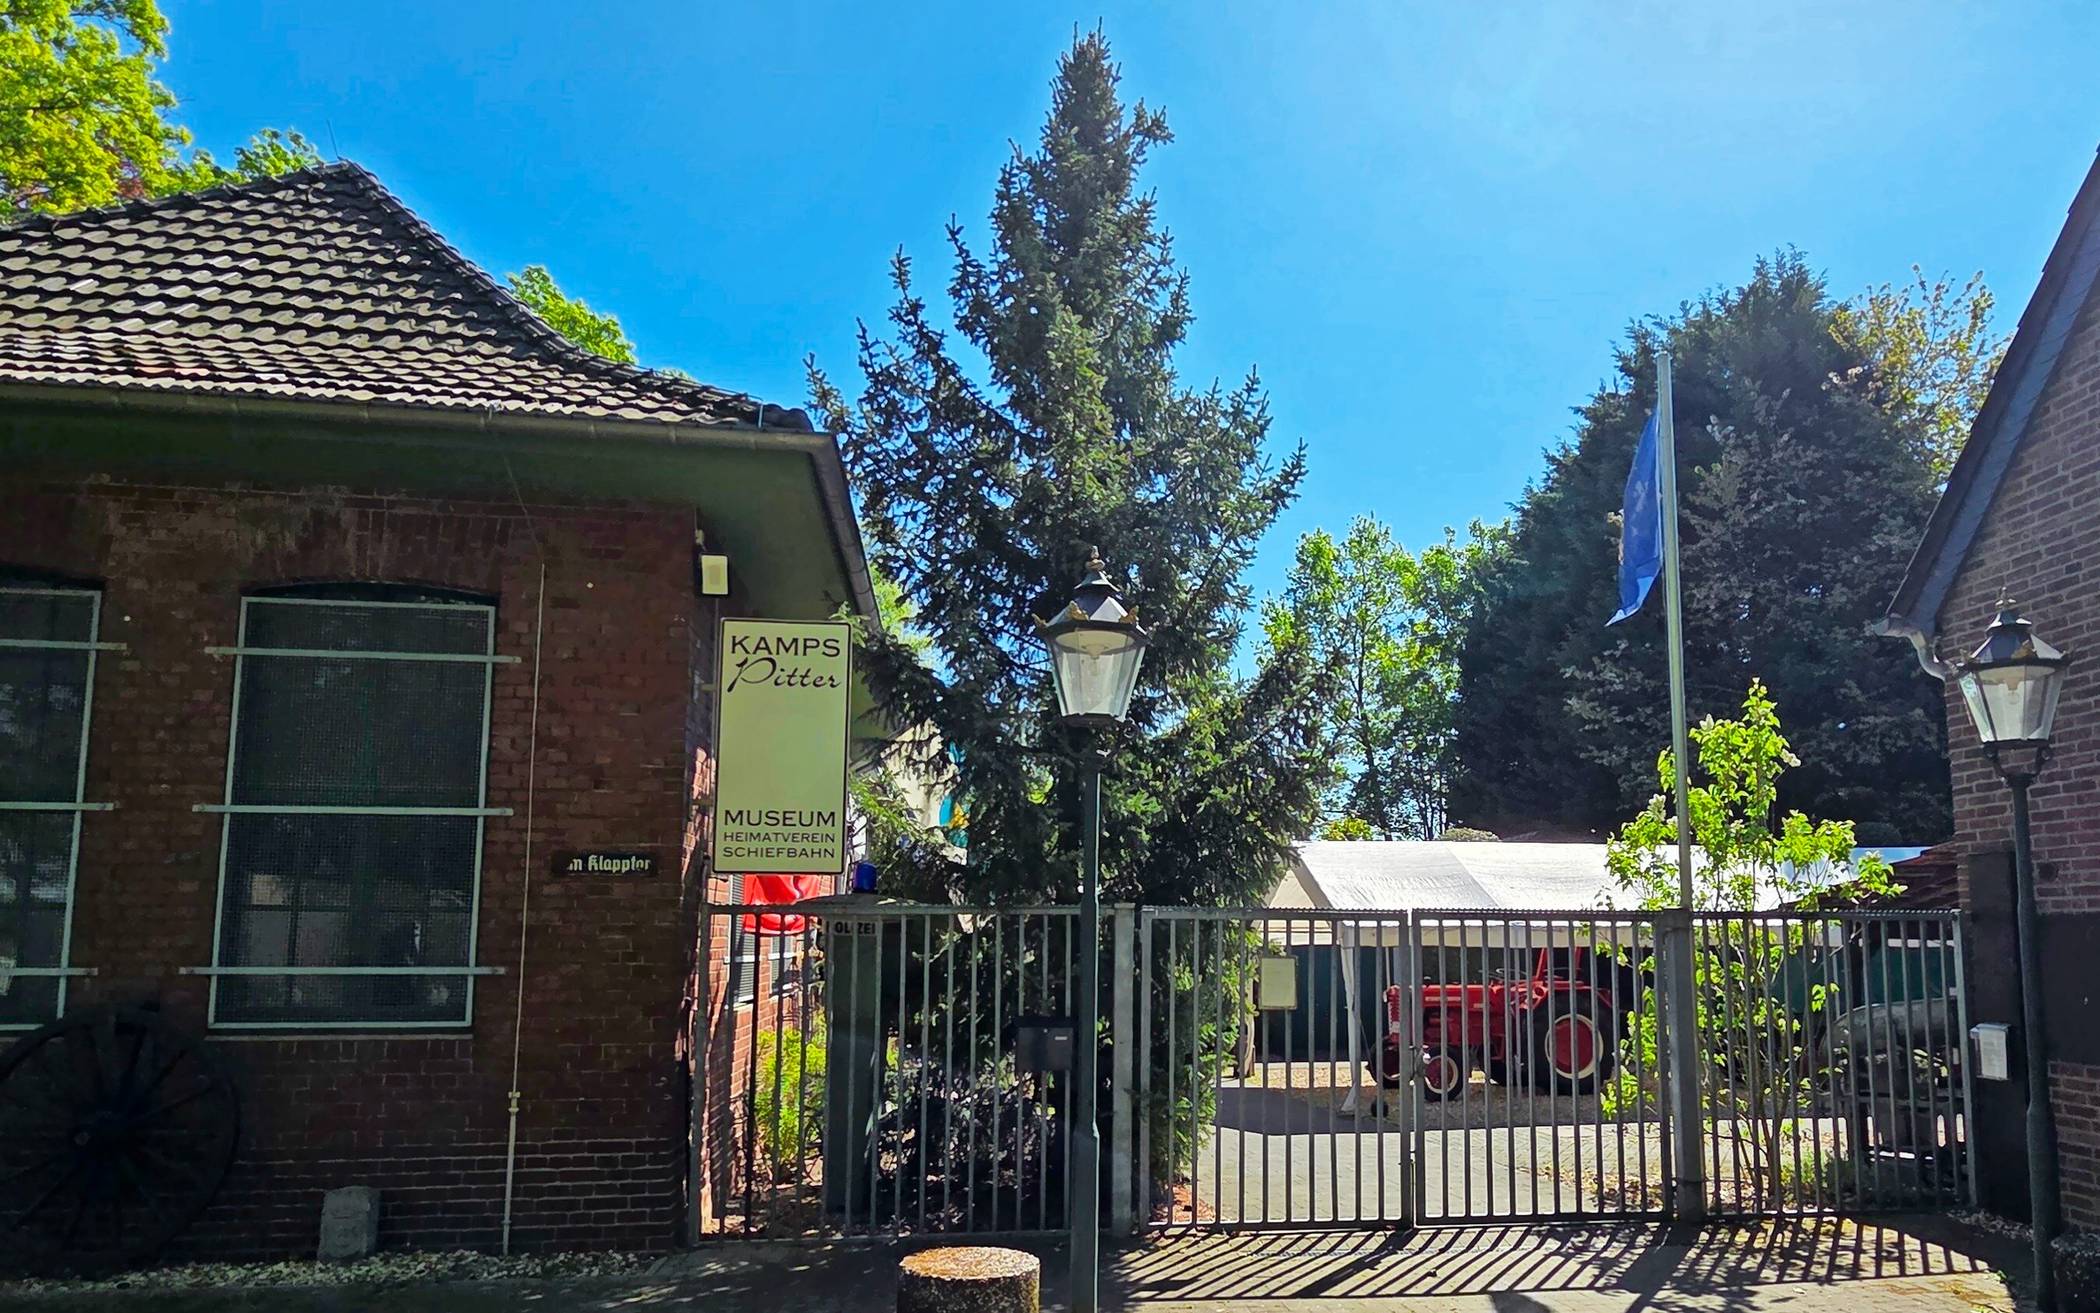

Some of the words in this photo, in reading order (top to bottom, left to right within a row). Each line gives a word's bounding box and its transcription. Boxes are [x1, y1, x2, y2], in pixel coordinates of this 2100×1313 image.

[731, 635, 840, 657] KAMPS
[727, 657, 841, 693] Pitter
[724, 810, 836, 827] MUSEUM
[723, 832, 835, 843] HEIMATVEREIN
[723, 847, 835, 858] SCHIEFBAHN
